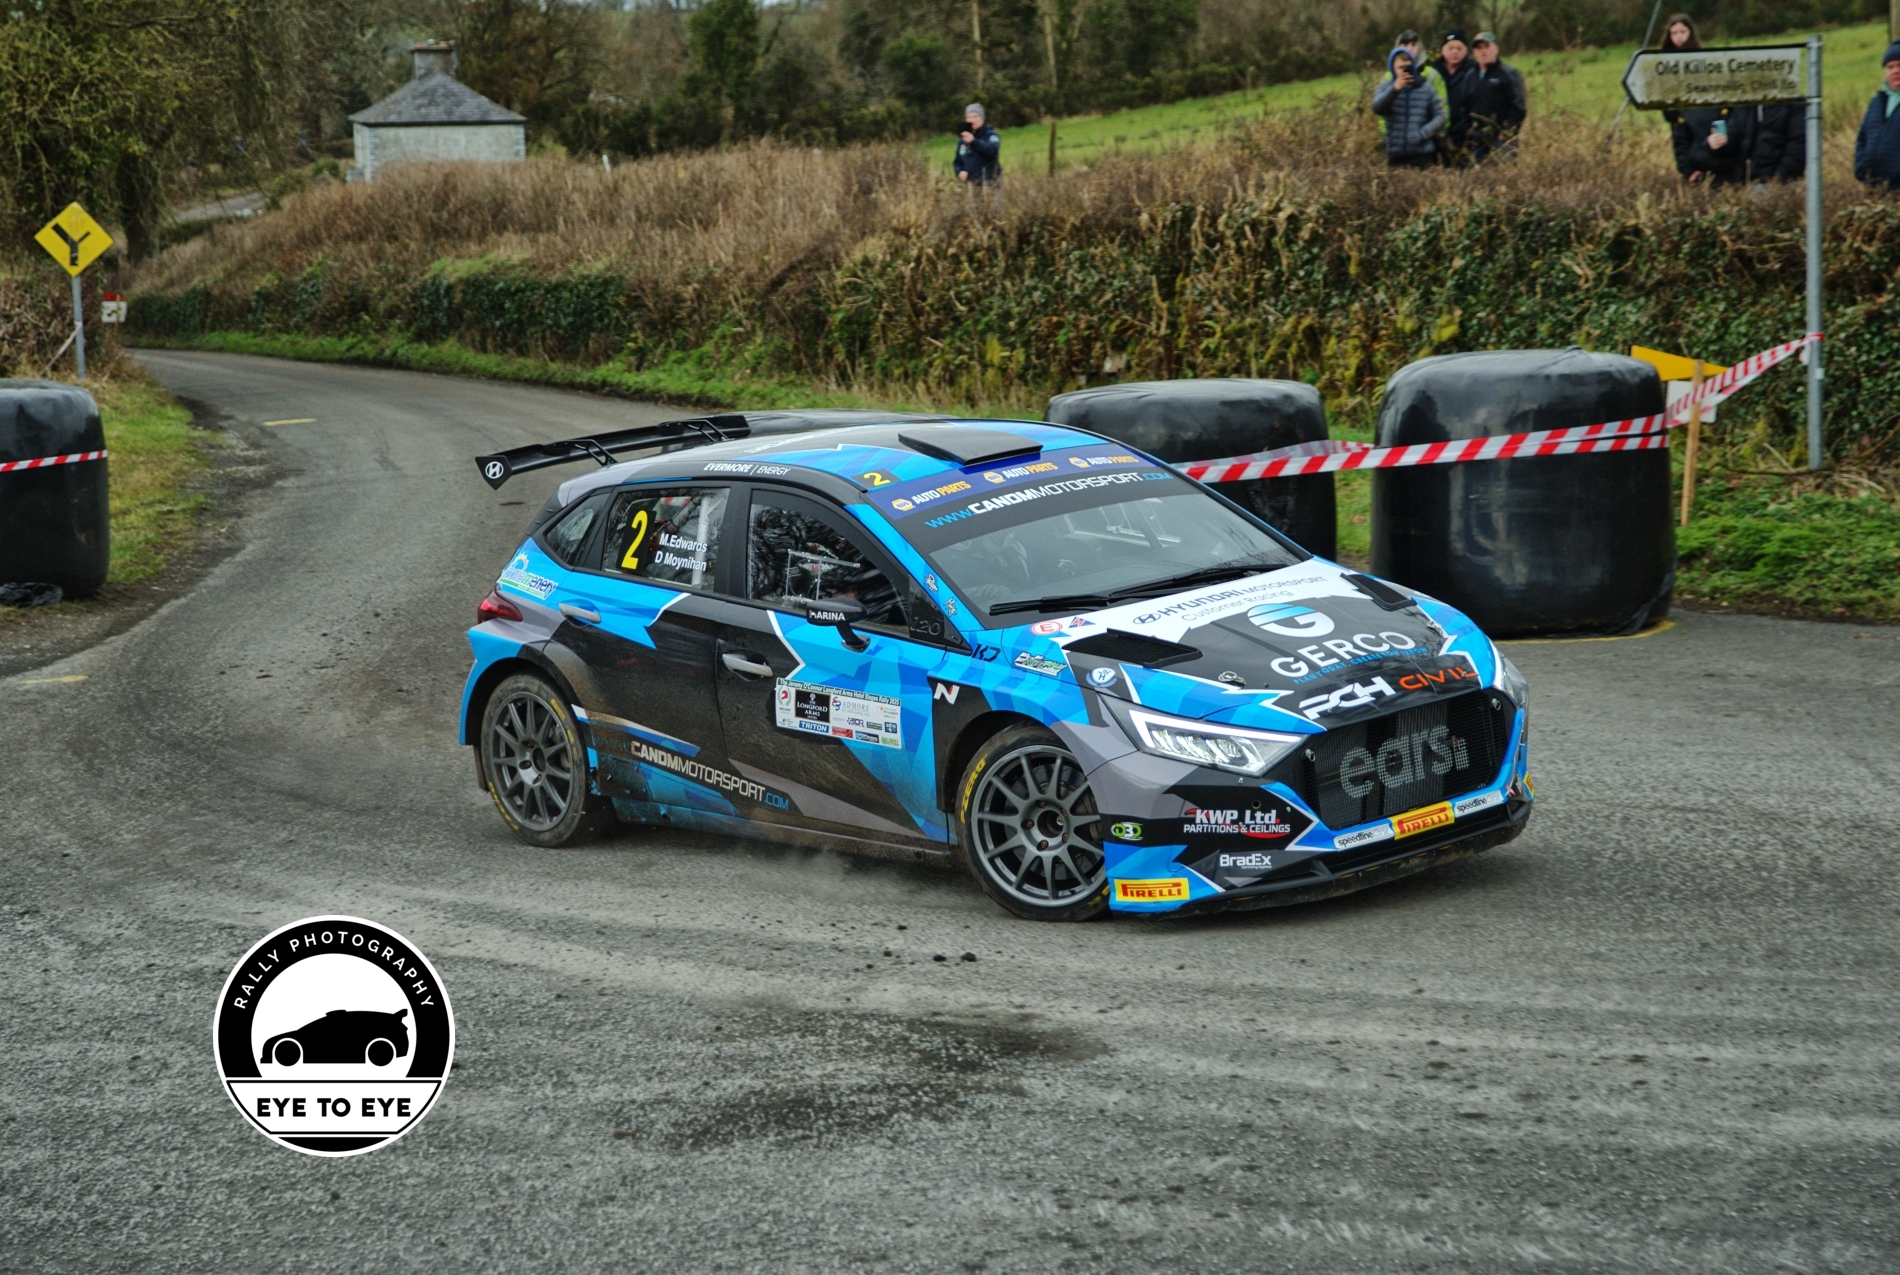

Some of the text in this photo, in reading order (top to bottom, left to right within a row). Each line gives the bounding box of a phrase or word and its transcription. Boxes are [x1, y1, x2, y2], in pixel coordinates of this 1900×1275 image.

[1655, 60, 1679, 76] Old
[1728, 58, 1796, 74] Cemetery
[704, 463, 792, 476] EVERMORE ENERGY
[864, 472, 892, 486] 2
[621, 510, 648, 570] 2
[659, 532, 708, 552] M.Edwards
[654, 551, 707, 572] D Moynihan
[1158, 576, 1328, 616] HYUNDAI MOTORSPORT
[1182, 590, 1294, 622] Customer Racing
[1270, 632, 1416, 678] GERCO
[1294, 674, 1316, 685] PLAN
[1399, 666, 1480, 690] CIVIL
[842, 689, 853, 697] Arms
[797, 702, 828, 712] LONGFORD
[842, 701, 870, 712] ADMORE
[801, 722, 827, 732] TRITON
[1340, 725, 1454, 798] ears
[1456, 797, 1488, 814] speedline
[1195, 808, 1238, 824] KWP
[1398, 806, 1450, 834] PIRELLI
[1184, 824, 1291, 834] PARTITIONS & CEILINGS
[1338, 828, 1390, 848] speedline Corse
[1220, 854, 1272, 867] BradEx
[1121, 882, 1182, 898] PIRELLI
